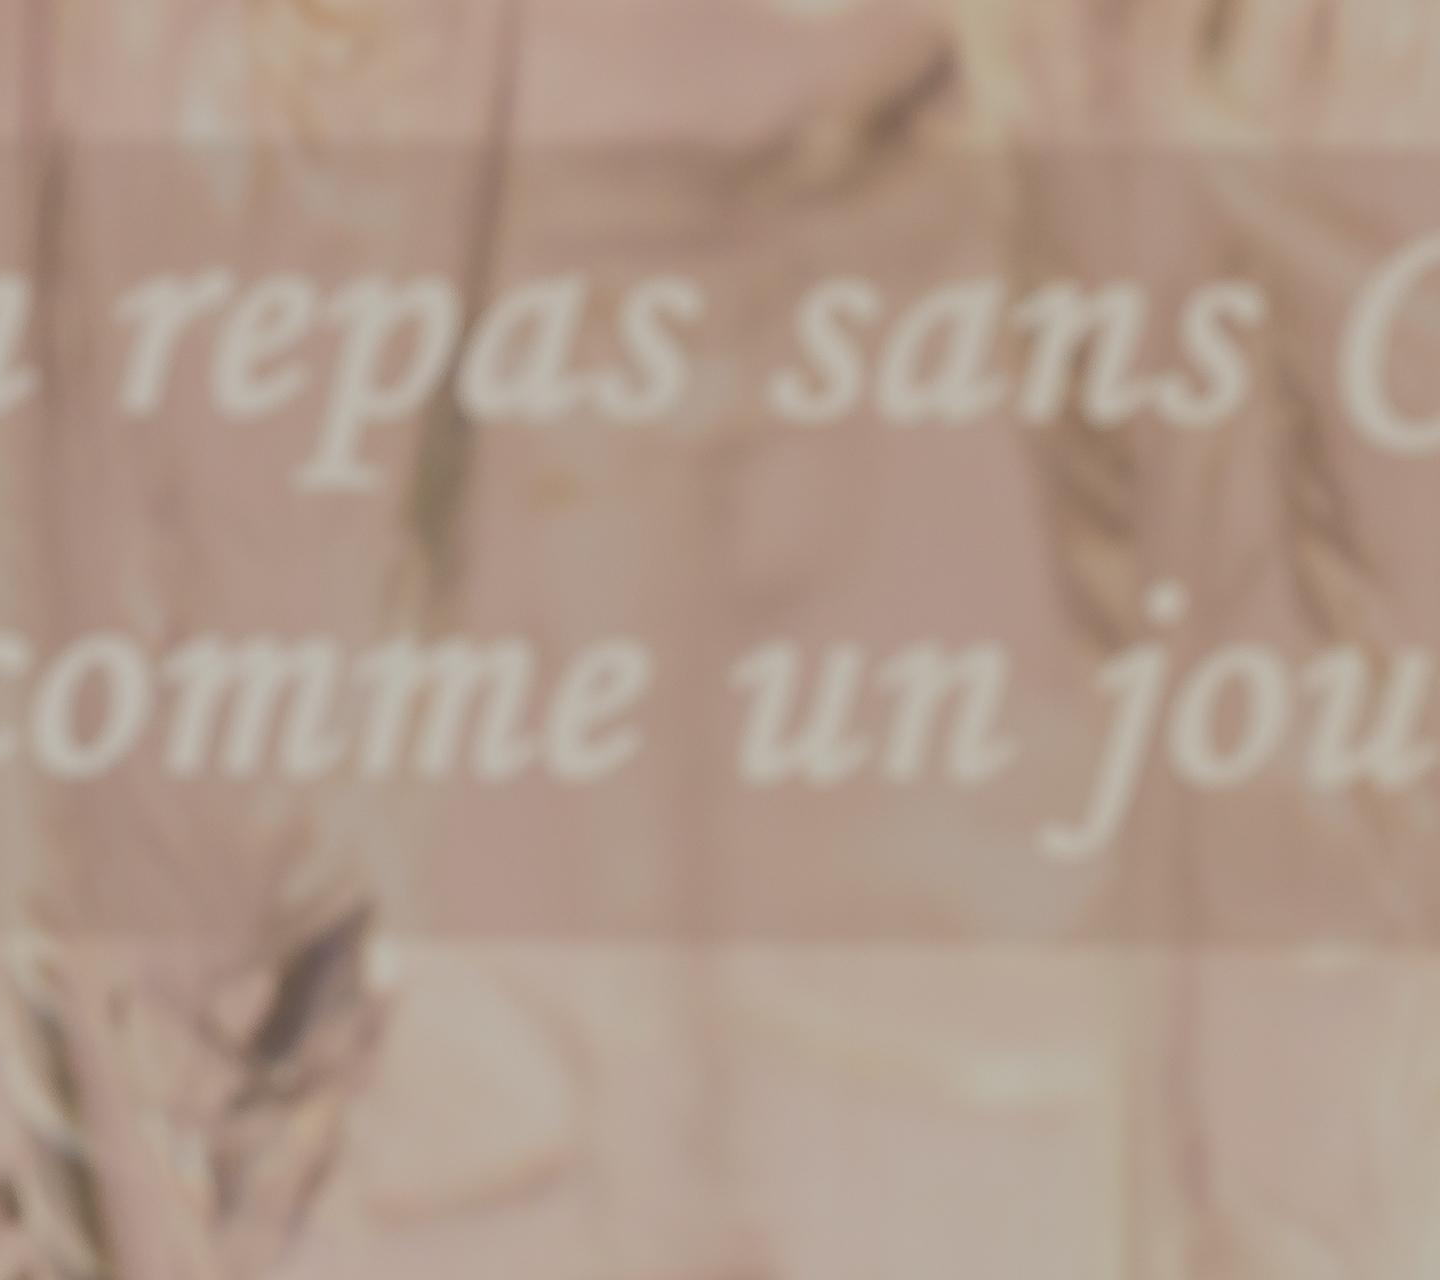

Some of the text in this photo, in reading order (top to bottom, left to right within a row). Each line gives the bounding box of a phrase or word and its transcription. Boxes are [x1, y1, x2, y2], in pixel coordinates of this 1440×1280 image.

[114, 266, 705, 491] repas
[768, 271, 1265, 430] sans
[730, 632, 1014, 786] un
